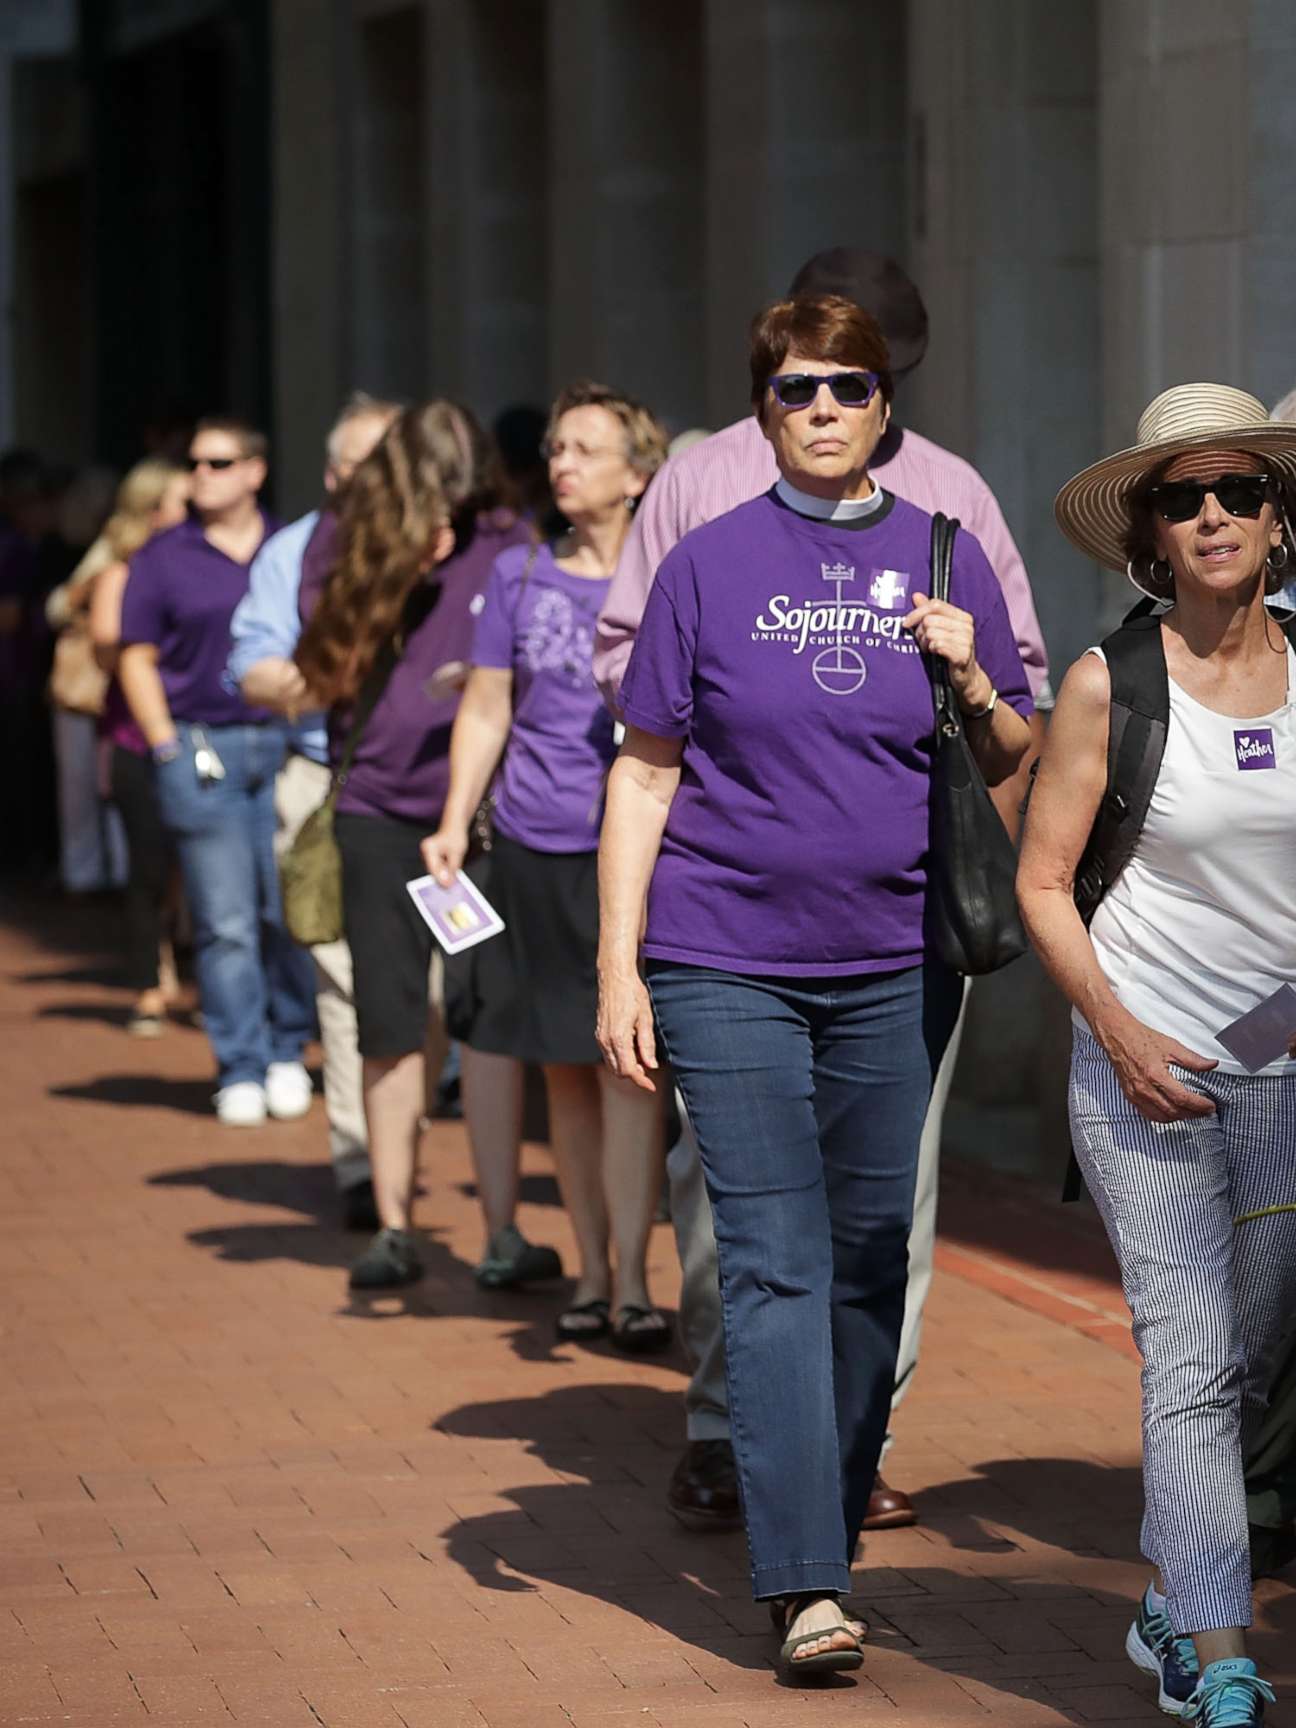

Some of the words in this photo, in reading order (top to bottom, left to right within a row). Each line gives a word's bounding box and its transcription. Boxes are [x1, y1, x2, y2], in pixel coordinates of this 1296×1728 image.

[751, 632, 799, 643] UNITED
[809, 635, 861, 646] CHURCH
[865, 638, 881, 648] OF
[756, 595, 913, 654] Sojourner
